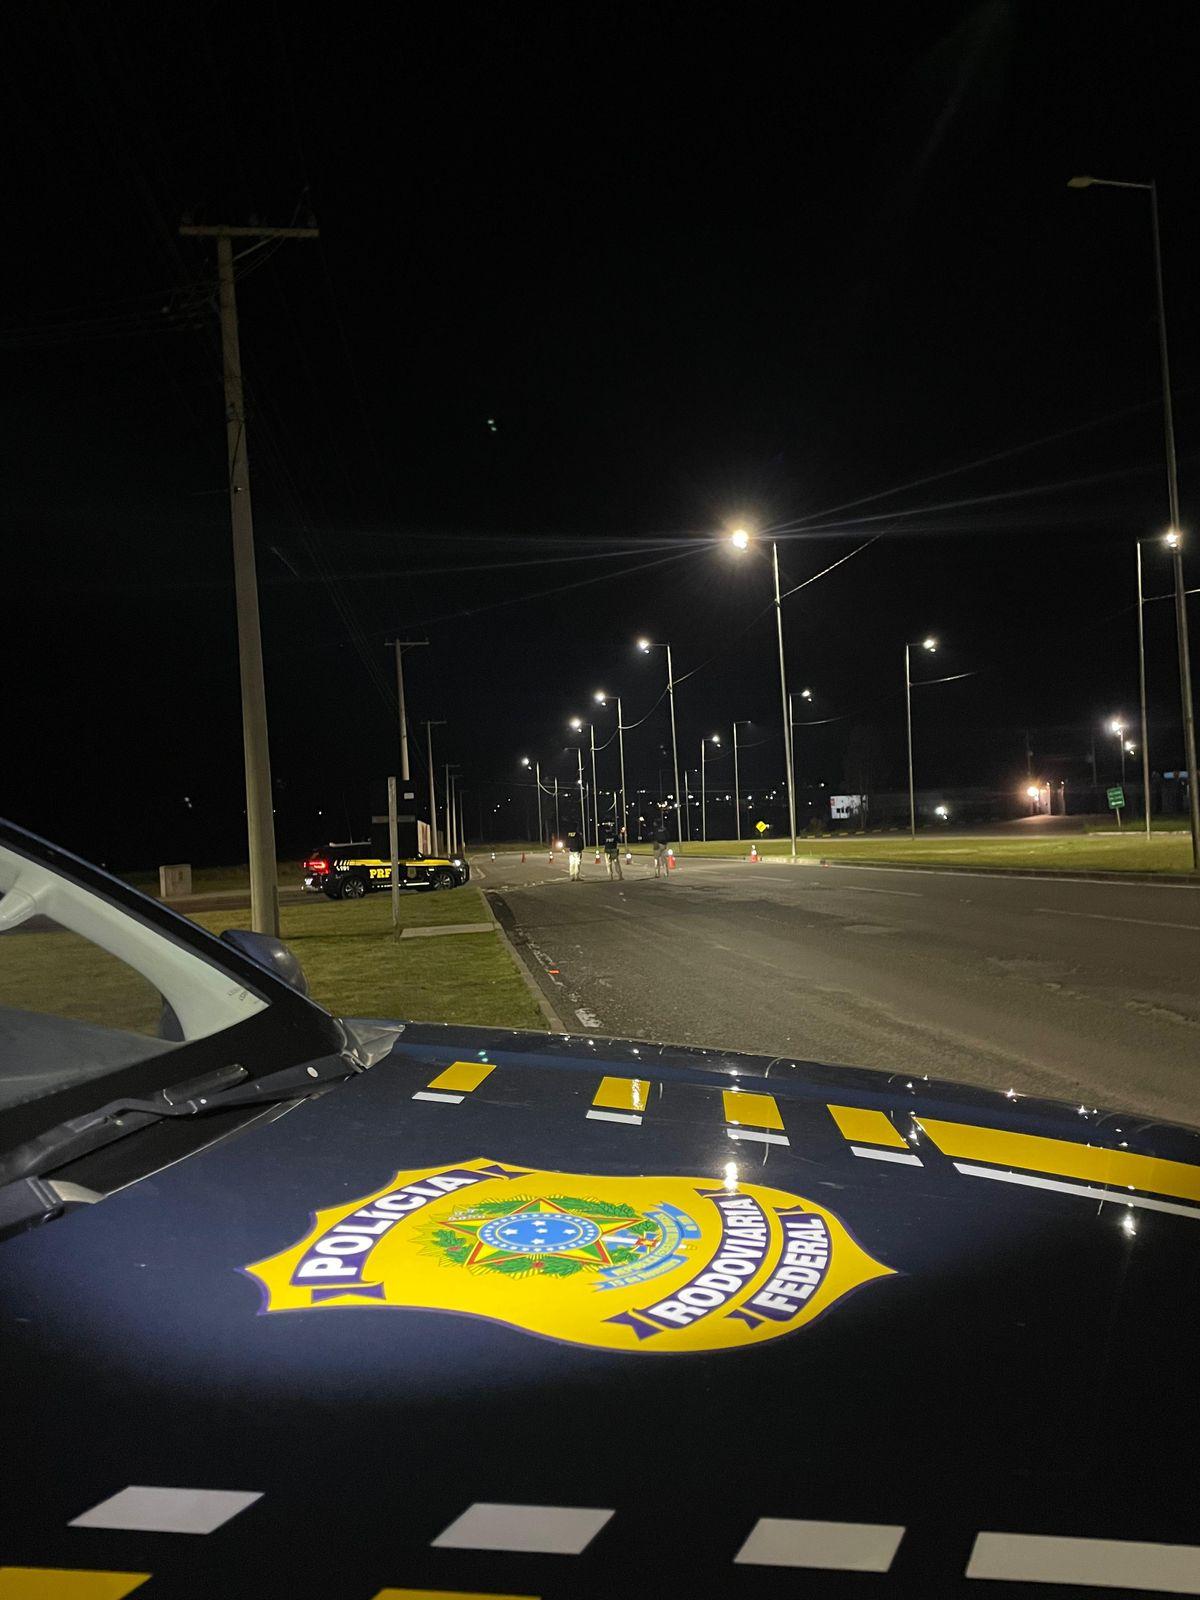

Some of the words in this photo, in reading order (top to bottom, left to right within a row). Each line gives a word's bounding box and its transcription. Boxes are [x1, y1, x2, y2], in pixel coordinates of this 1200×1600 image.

[369, 868, 392, 878] PRF
[297, 1176, 480, 1277] POLÍCIA
[647, 1198, 767, 1324] RODOVIÁRIA
[751, 1218, 829, 1313] FEDERAL
